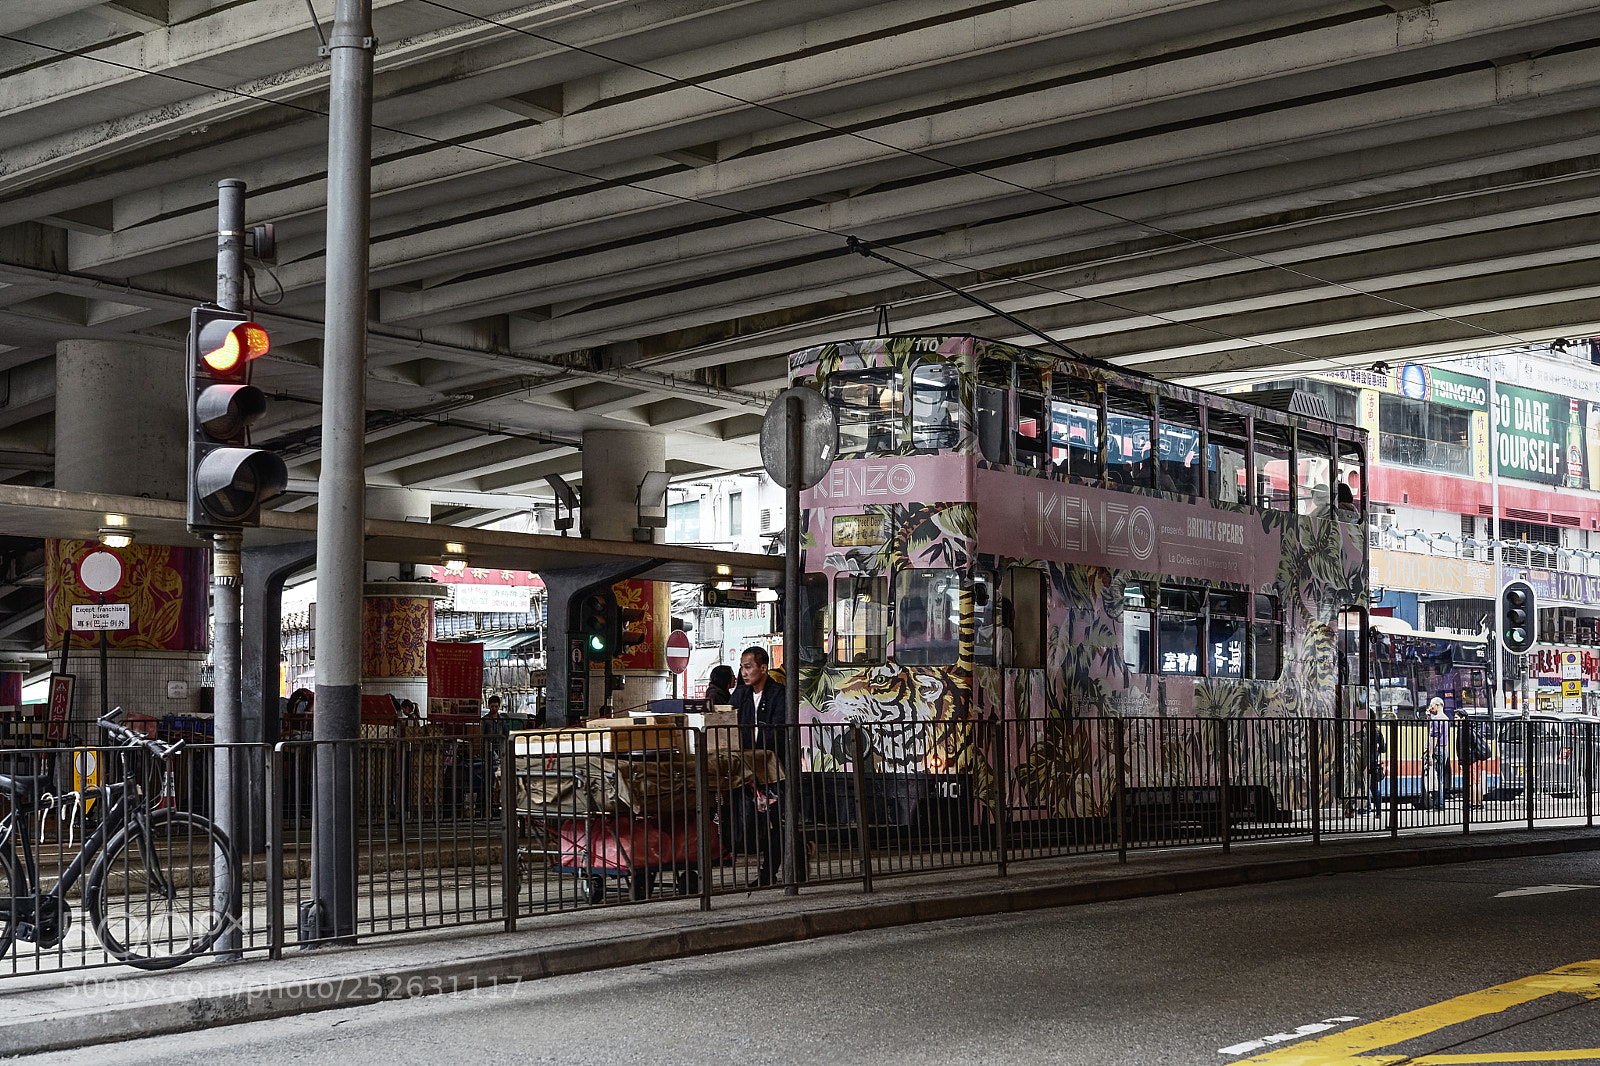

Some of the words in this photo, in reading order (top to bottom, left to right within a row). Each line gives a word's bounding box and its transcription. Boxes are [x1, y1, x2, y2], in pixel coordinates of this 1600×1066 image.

[915, 339, 939, 352] 110
[1432, 378, 1486, 406] TSINGTAO
[1514, 396, 1550, 436] DARE
[1496, 431, 1560, 476] OURSELF
[813, 463, 916, 500] KENZO
[1036, 490, 1156, 562] KENZO
[1160, 525, 1185, 537] presents
[1186, 516, 1217, 541] BRITNEY
[1217, 521, 1244, 545] SPEARS
[1383, 553, 1464, 591] 3100-0553
[75, 606, 95, 614] Except
[97, 605, 127, 613] franchised
